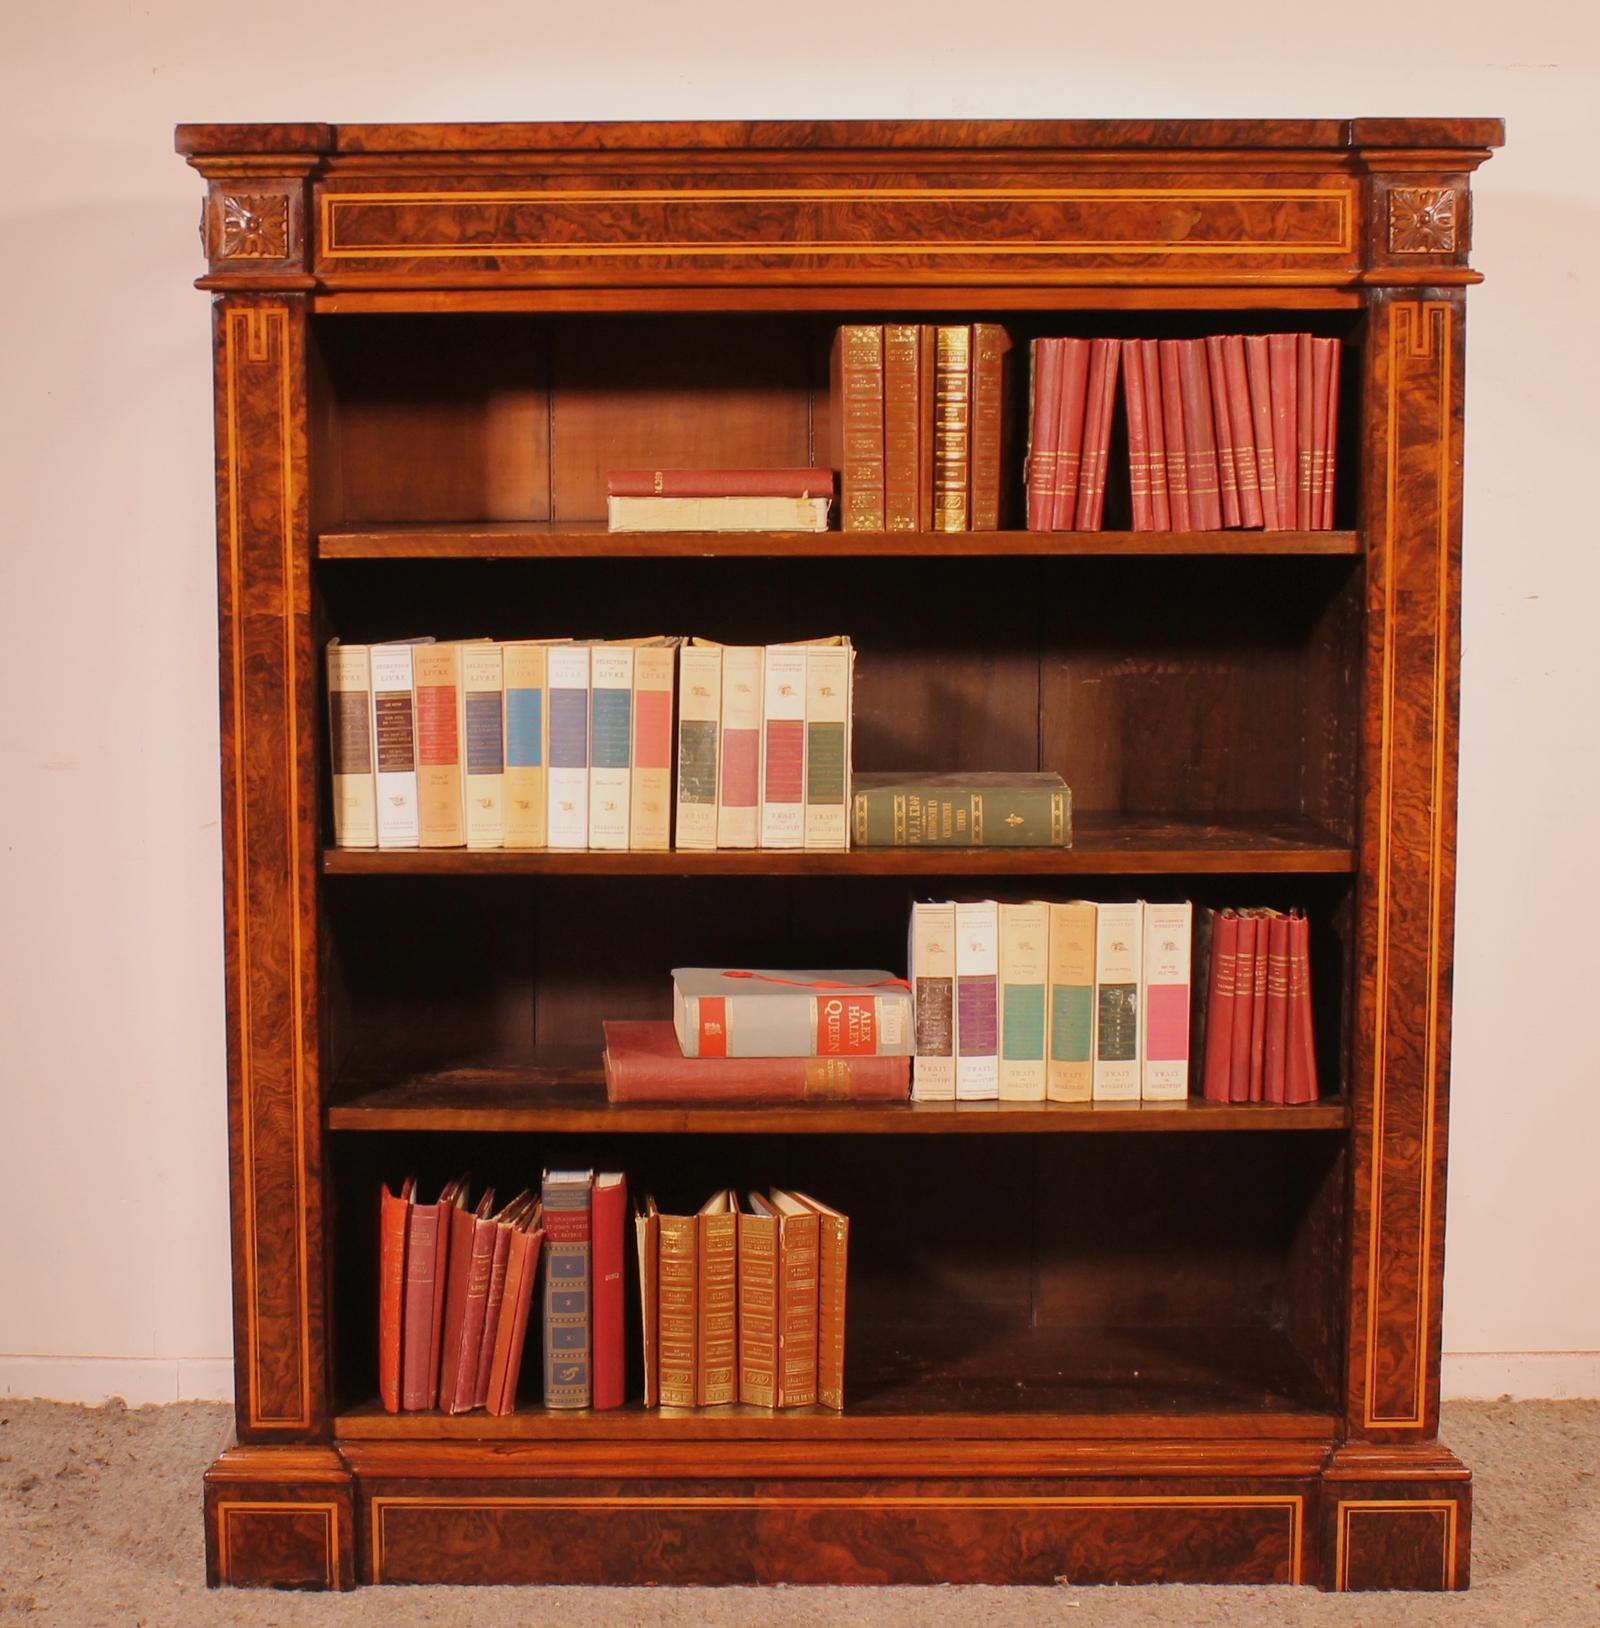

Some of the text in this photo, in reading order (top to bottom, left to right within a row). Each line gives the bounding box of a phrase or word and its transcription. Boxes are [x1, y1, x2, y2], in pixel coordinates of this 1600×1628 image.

[824, 1000, 842, 1052] QUEEN
[848, 1006, 860, 1047] HALEY
[860, 1010, 872, 1042] ALEX
